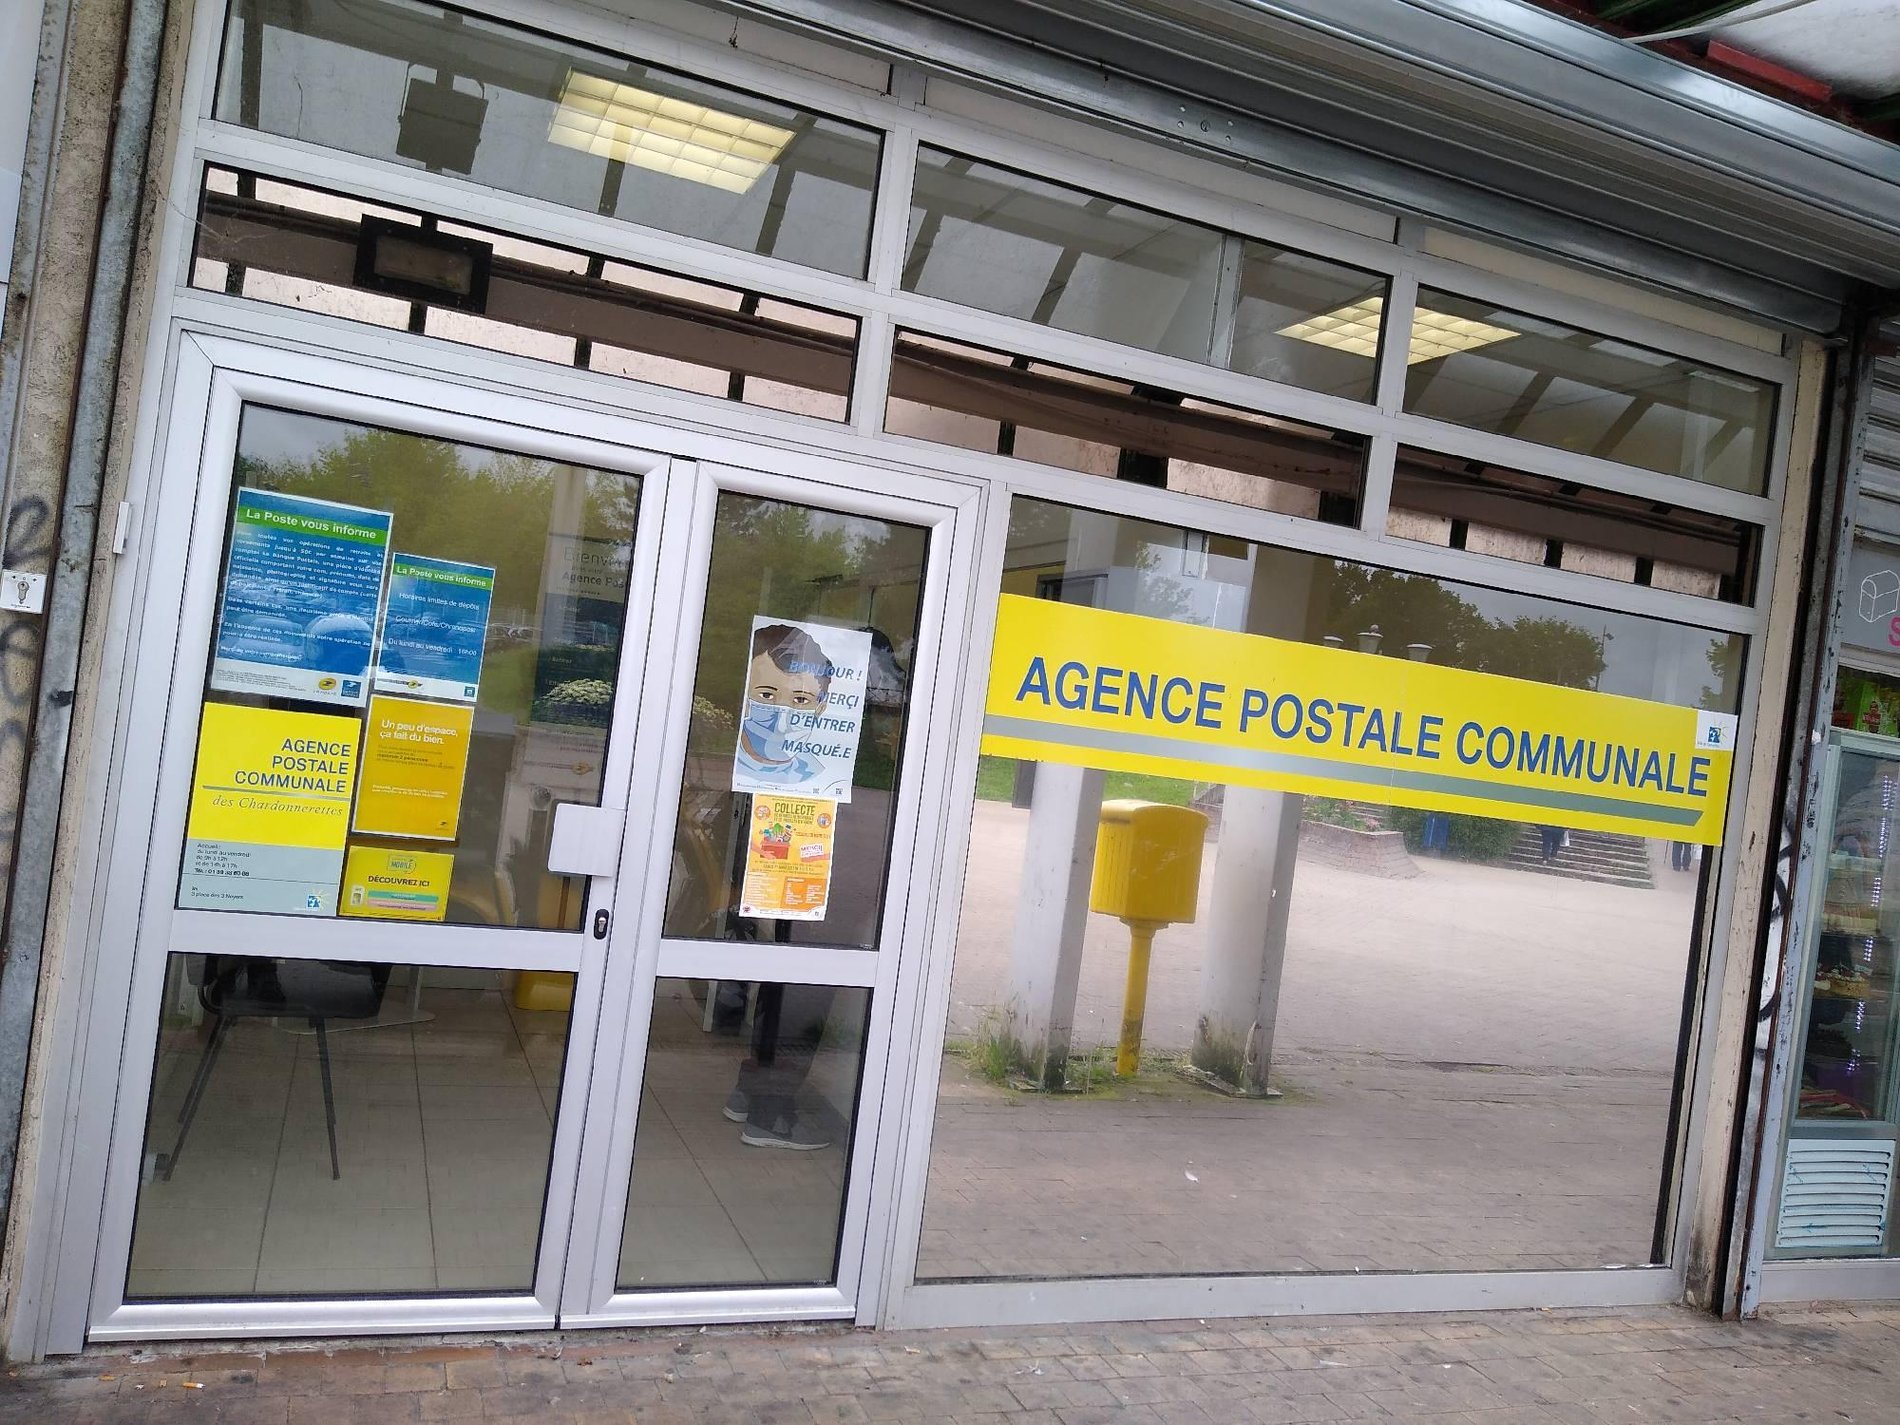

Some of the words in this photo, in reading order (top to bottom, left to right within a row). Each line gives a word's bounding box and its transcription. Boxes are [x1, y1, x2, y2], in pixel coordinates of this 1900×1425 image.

[247, 509, 260, 519] La
[264, 512, 297, 525] Poste
[301, 519, 329, 531] vous
[332, 524, 377, 539] informe
[409, 568, 432, 577] Poste
[434, 572, 454, 581] vous
[455, 577, 486, 587] informe
[562, 571, 602, 586] Agence
[788, 661, 854, 679] BONJOUR
[858, 670, 862, 681] !
[381, 719, 395, 728] Un
[397, 722, 415, 731] peu
[1016, 656, 1226, 730] AGENCE
[1238, 688, 1448, 760] POSTALE
[1454, 721, 1712, 798] COMMUNALE
[380, 730, 391, 739] ça
[394, 732, 407, 740] fait
[423, 735, 444, 744] bien.
[282, 738, 352, 757] AGENCE
[781, 739, 851, 759] MASQUÉ.E
[272, 756, 349, 775] POSTALE
[235, 771, 347, 793] COMMUNALE
[212, 795, 233, 807] des
[238, 797, 343, 816] Chardonnerettes
[774, 803, 815, 816] COLLECTE
[368, 875, 418, 886] DÉCOUVREZ
